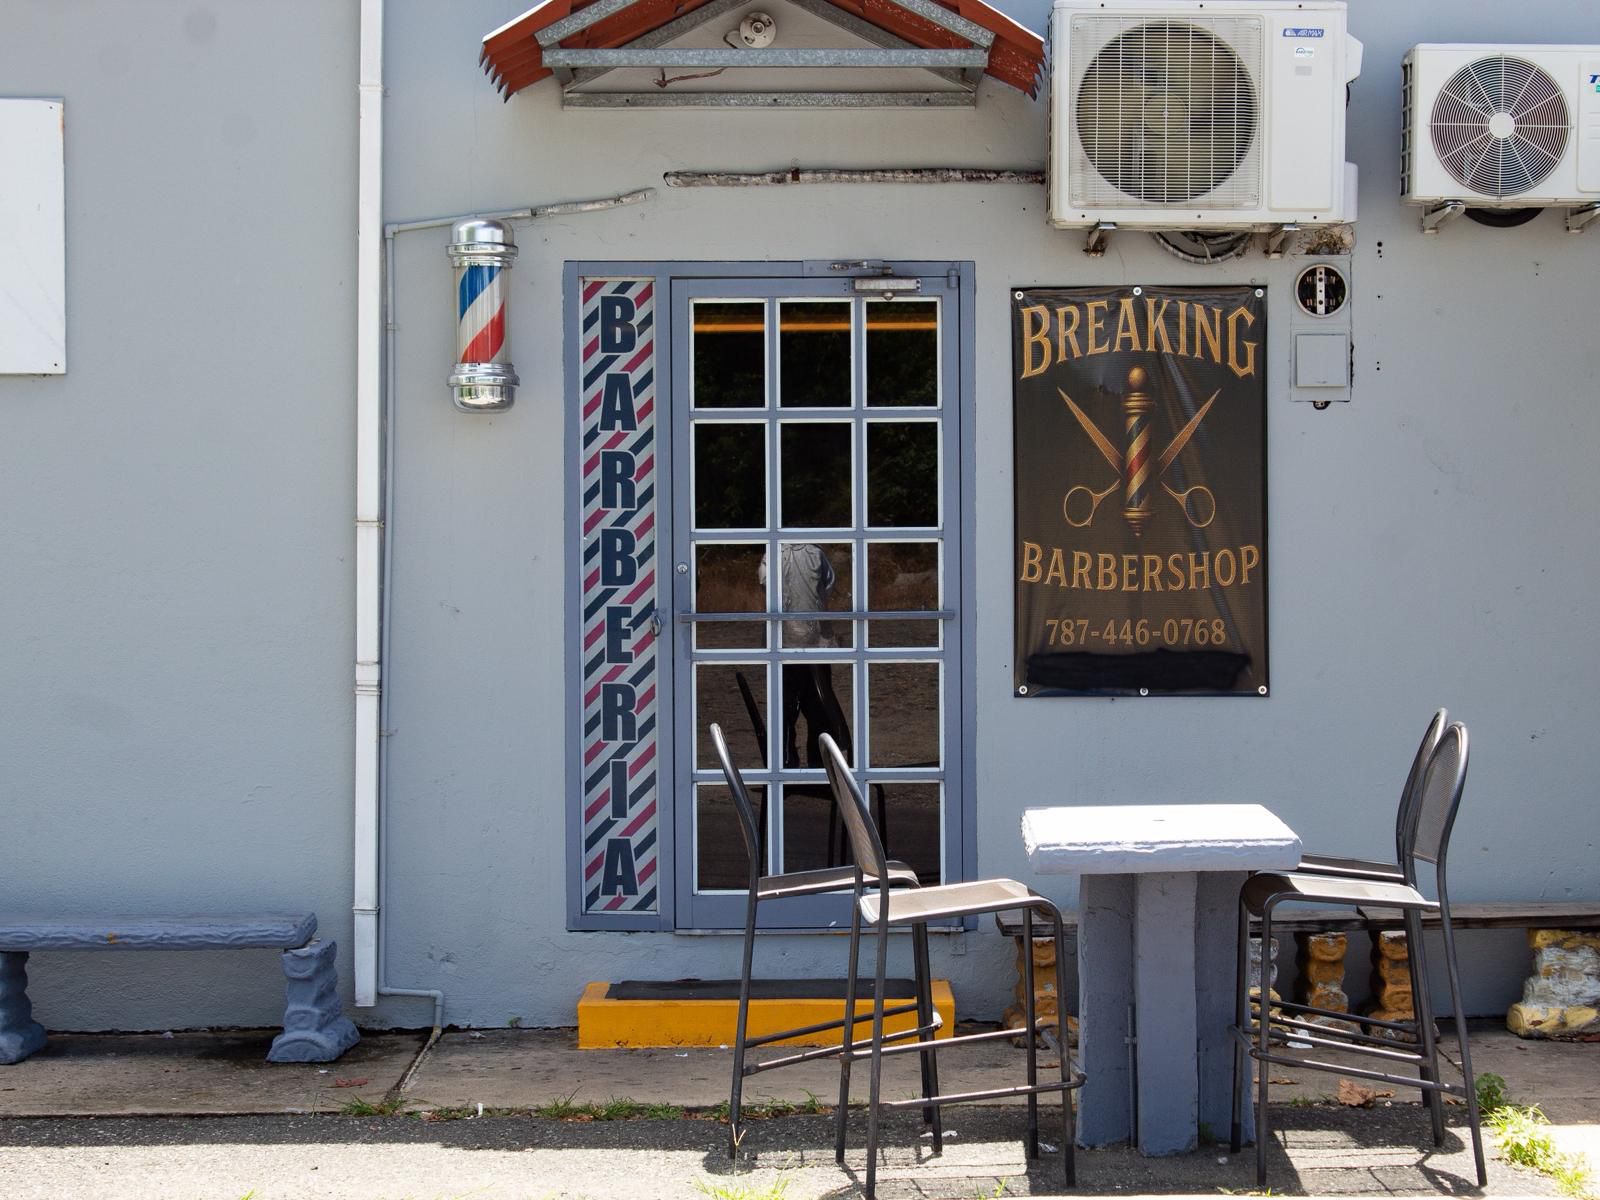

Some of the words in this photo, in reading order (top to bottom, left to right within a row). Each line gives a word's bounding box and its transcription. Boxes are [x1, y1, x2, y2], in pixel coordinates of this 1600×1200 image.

[1020, 298, 1258, 379] BREAKING
[599, 295, 638, 897] BARBERIA
[1020, 542, 1260, 592] BARBERSHOP
[1045, 619, 1227, 646] 787-446-0768
